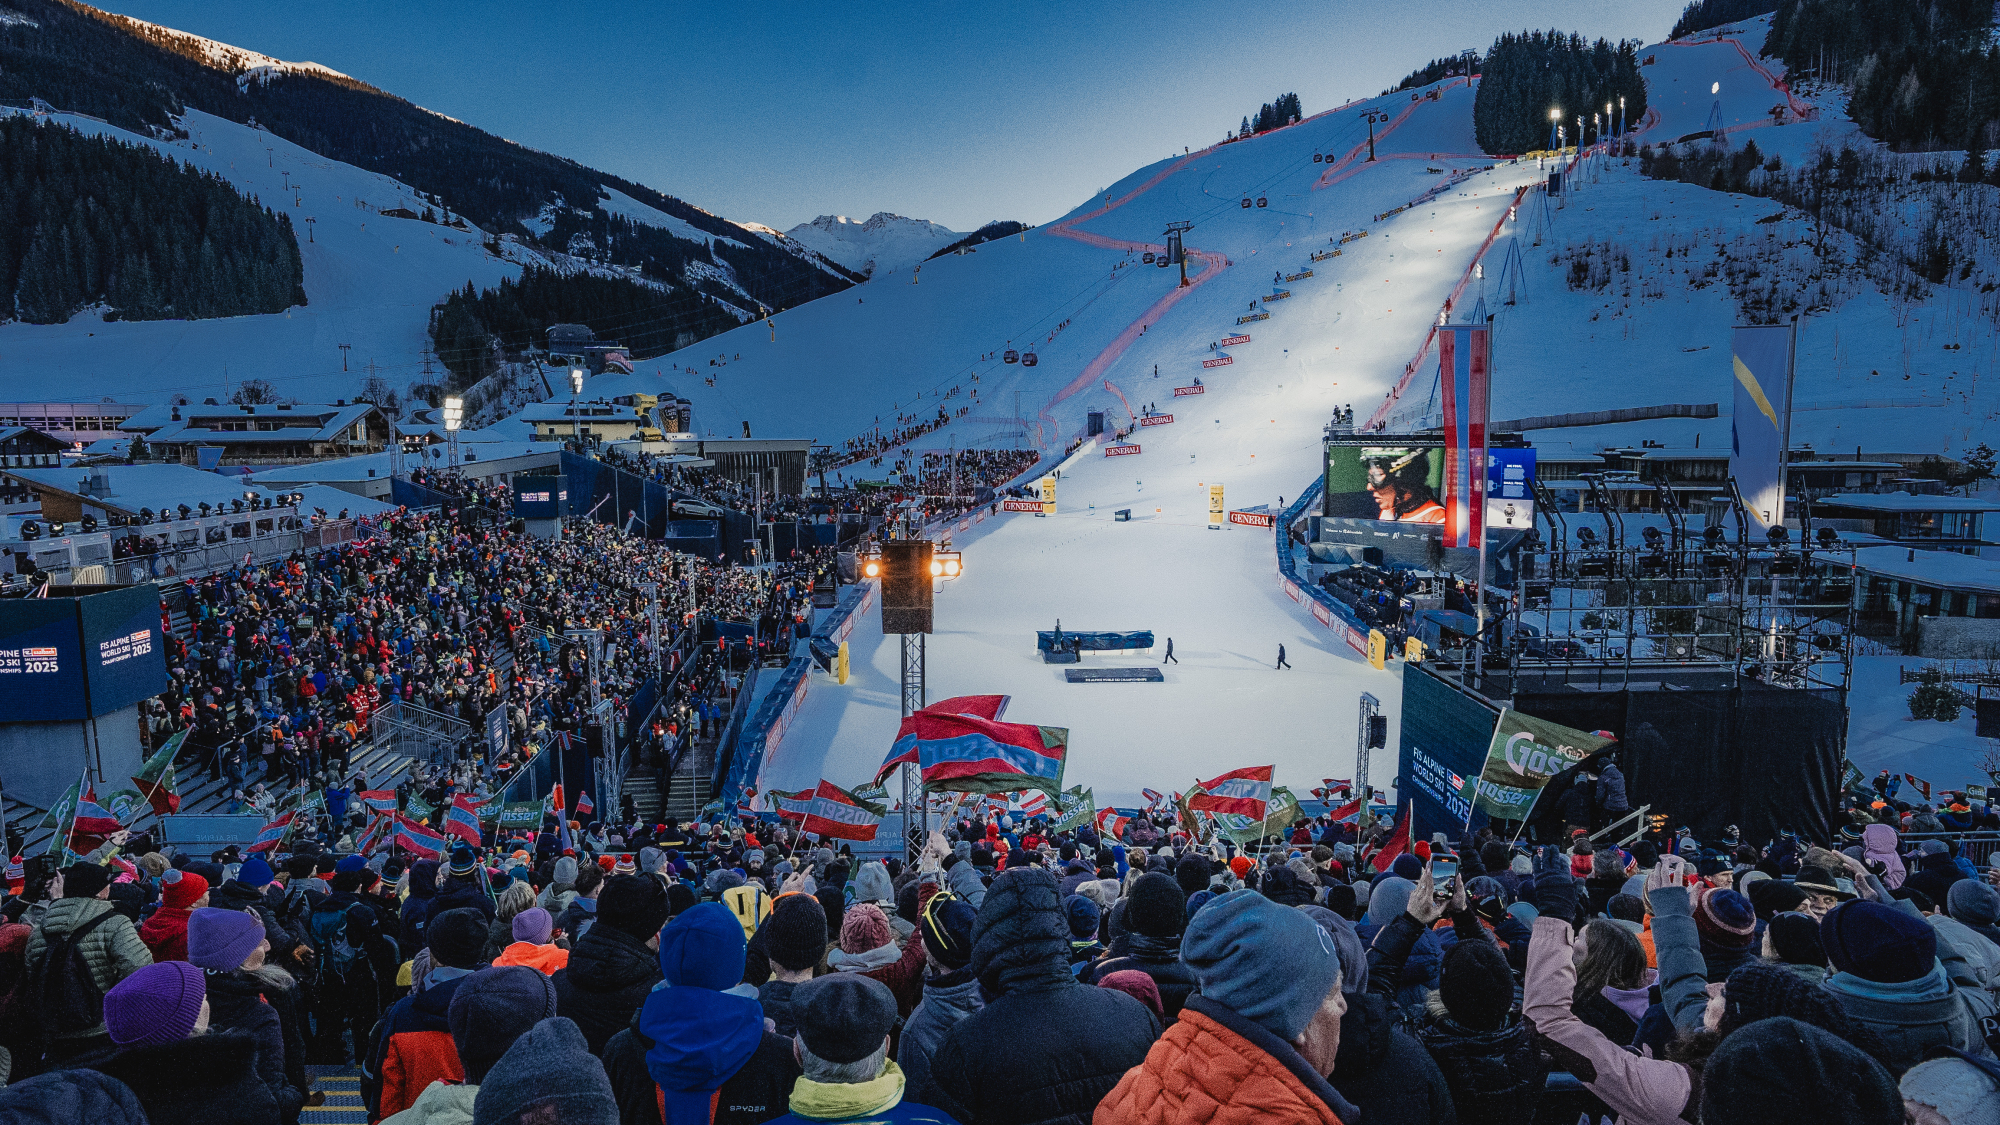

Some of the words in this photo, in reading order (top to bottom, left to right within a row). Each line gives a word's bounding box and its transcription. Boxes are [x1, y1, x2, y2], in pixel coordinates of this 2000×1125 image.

[1175, 387, 1203, 395] GENERALI
[1142, 415, 1172, 425] GENERALI
[1107, 446, 1139, 455] GENERALI
[1005, 502, 1043, 511] GENERALI
[1231, 512, 1274, 526] GENERAL
[100, 641, 109, 650] FIS
[110, 636, 129, 647] ALPINE
[101, 648, 121, 658] WORLD
[122, 645, 130, 653] SKI
[133, 643, 151, 657] 2025
[25, 662, 58, 673] 2025
[1413, 746, 1423, 761] FIS
[1423, 755, 1445, 778] ALPINE
[1412, 760, 1434, 783] WORLD
[1434, 777, 1444, 792] SKI
[1446, 792, 1470, 824] 2025
